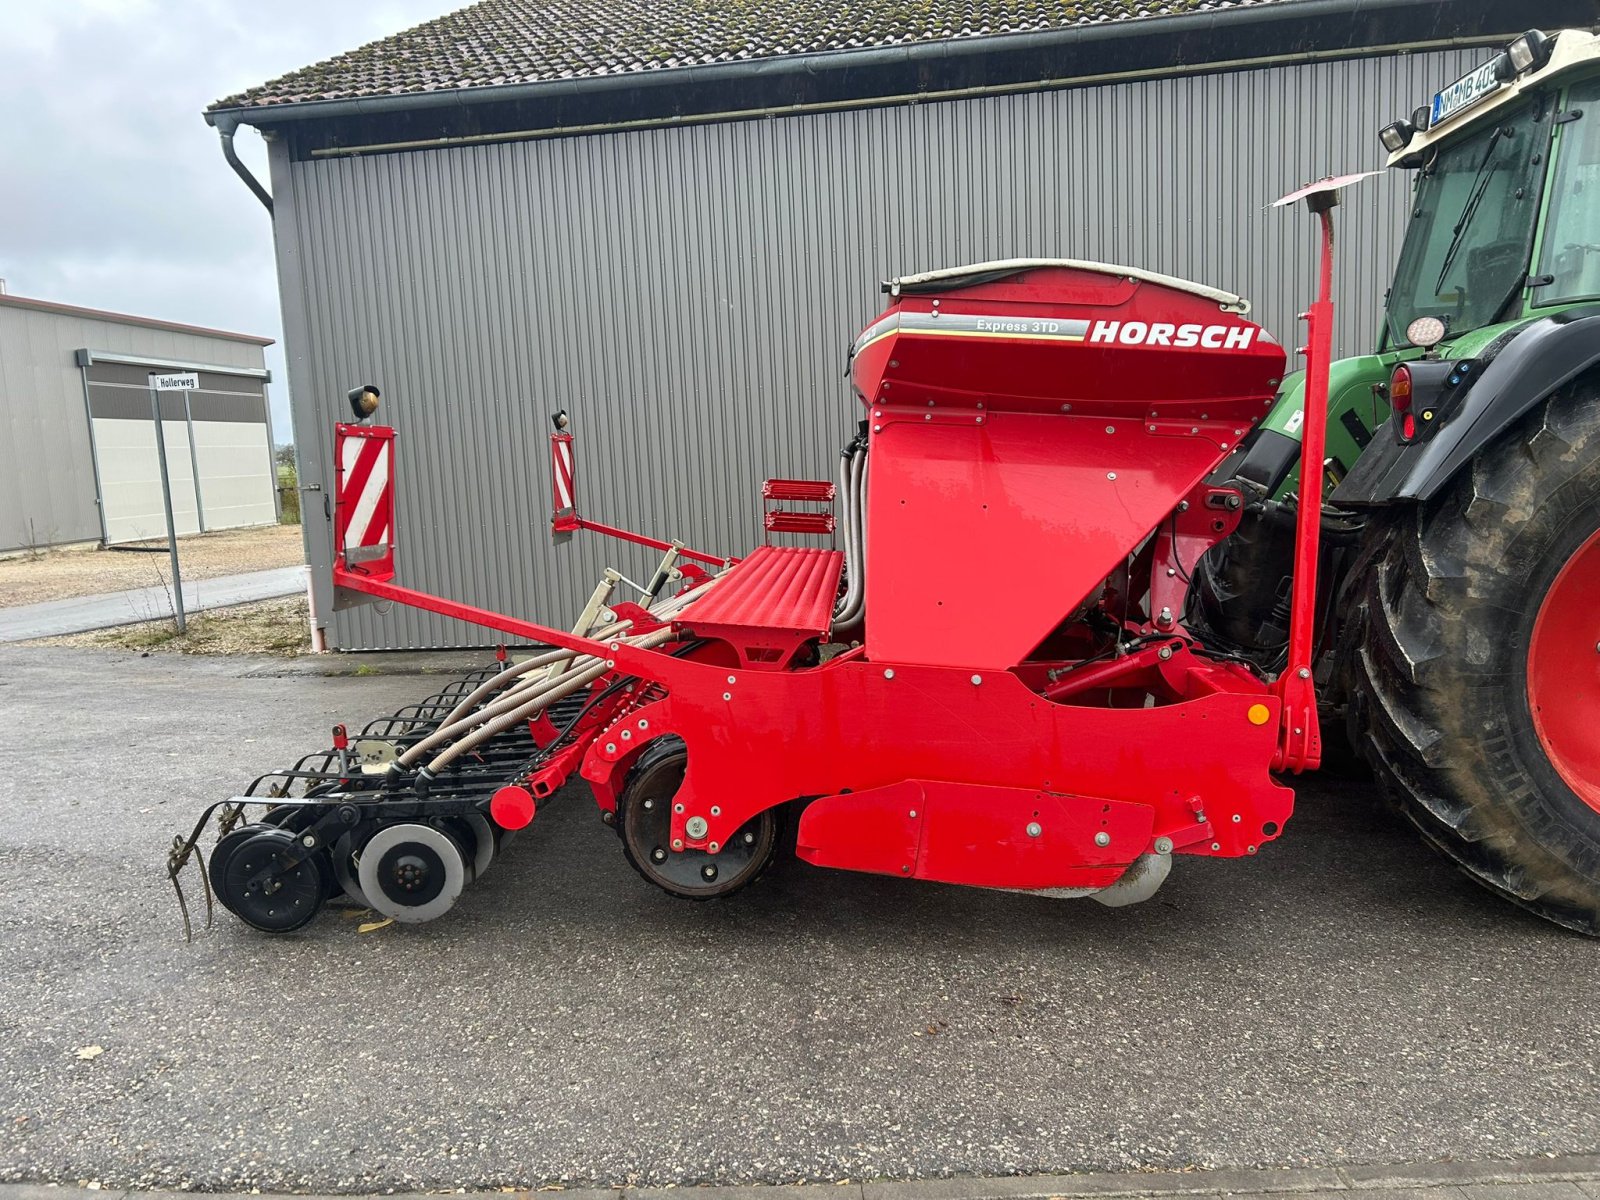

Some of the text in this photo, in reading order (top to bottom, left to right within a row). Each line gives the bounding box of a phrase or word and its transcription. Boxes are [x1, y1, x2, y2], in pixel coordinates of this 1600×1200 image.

[977, 319, 1059, 333] Express 3TD
[1090, 320, 1254, 349] HORSCH
[160, 377, 195, 388] Hollerweg
